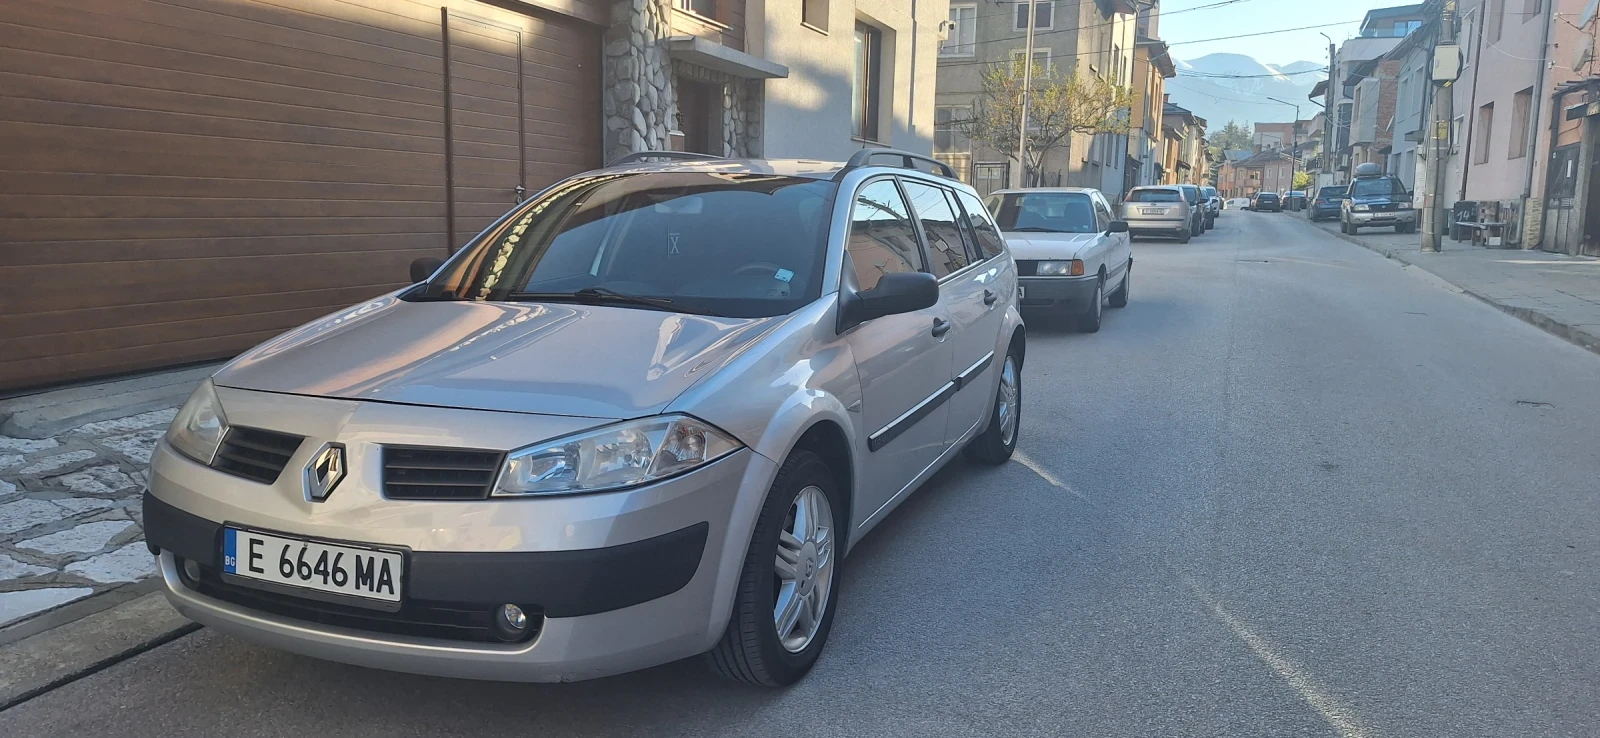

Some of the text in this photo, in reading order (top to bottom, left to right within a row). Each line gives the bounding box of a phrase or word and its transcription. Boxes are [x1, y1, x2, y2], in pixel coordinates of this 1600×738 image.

[225, 555, 236, 567] BG
[249, 538, 394, 595] E 6646 MA
